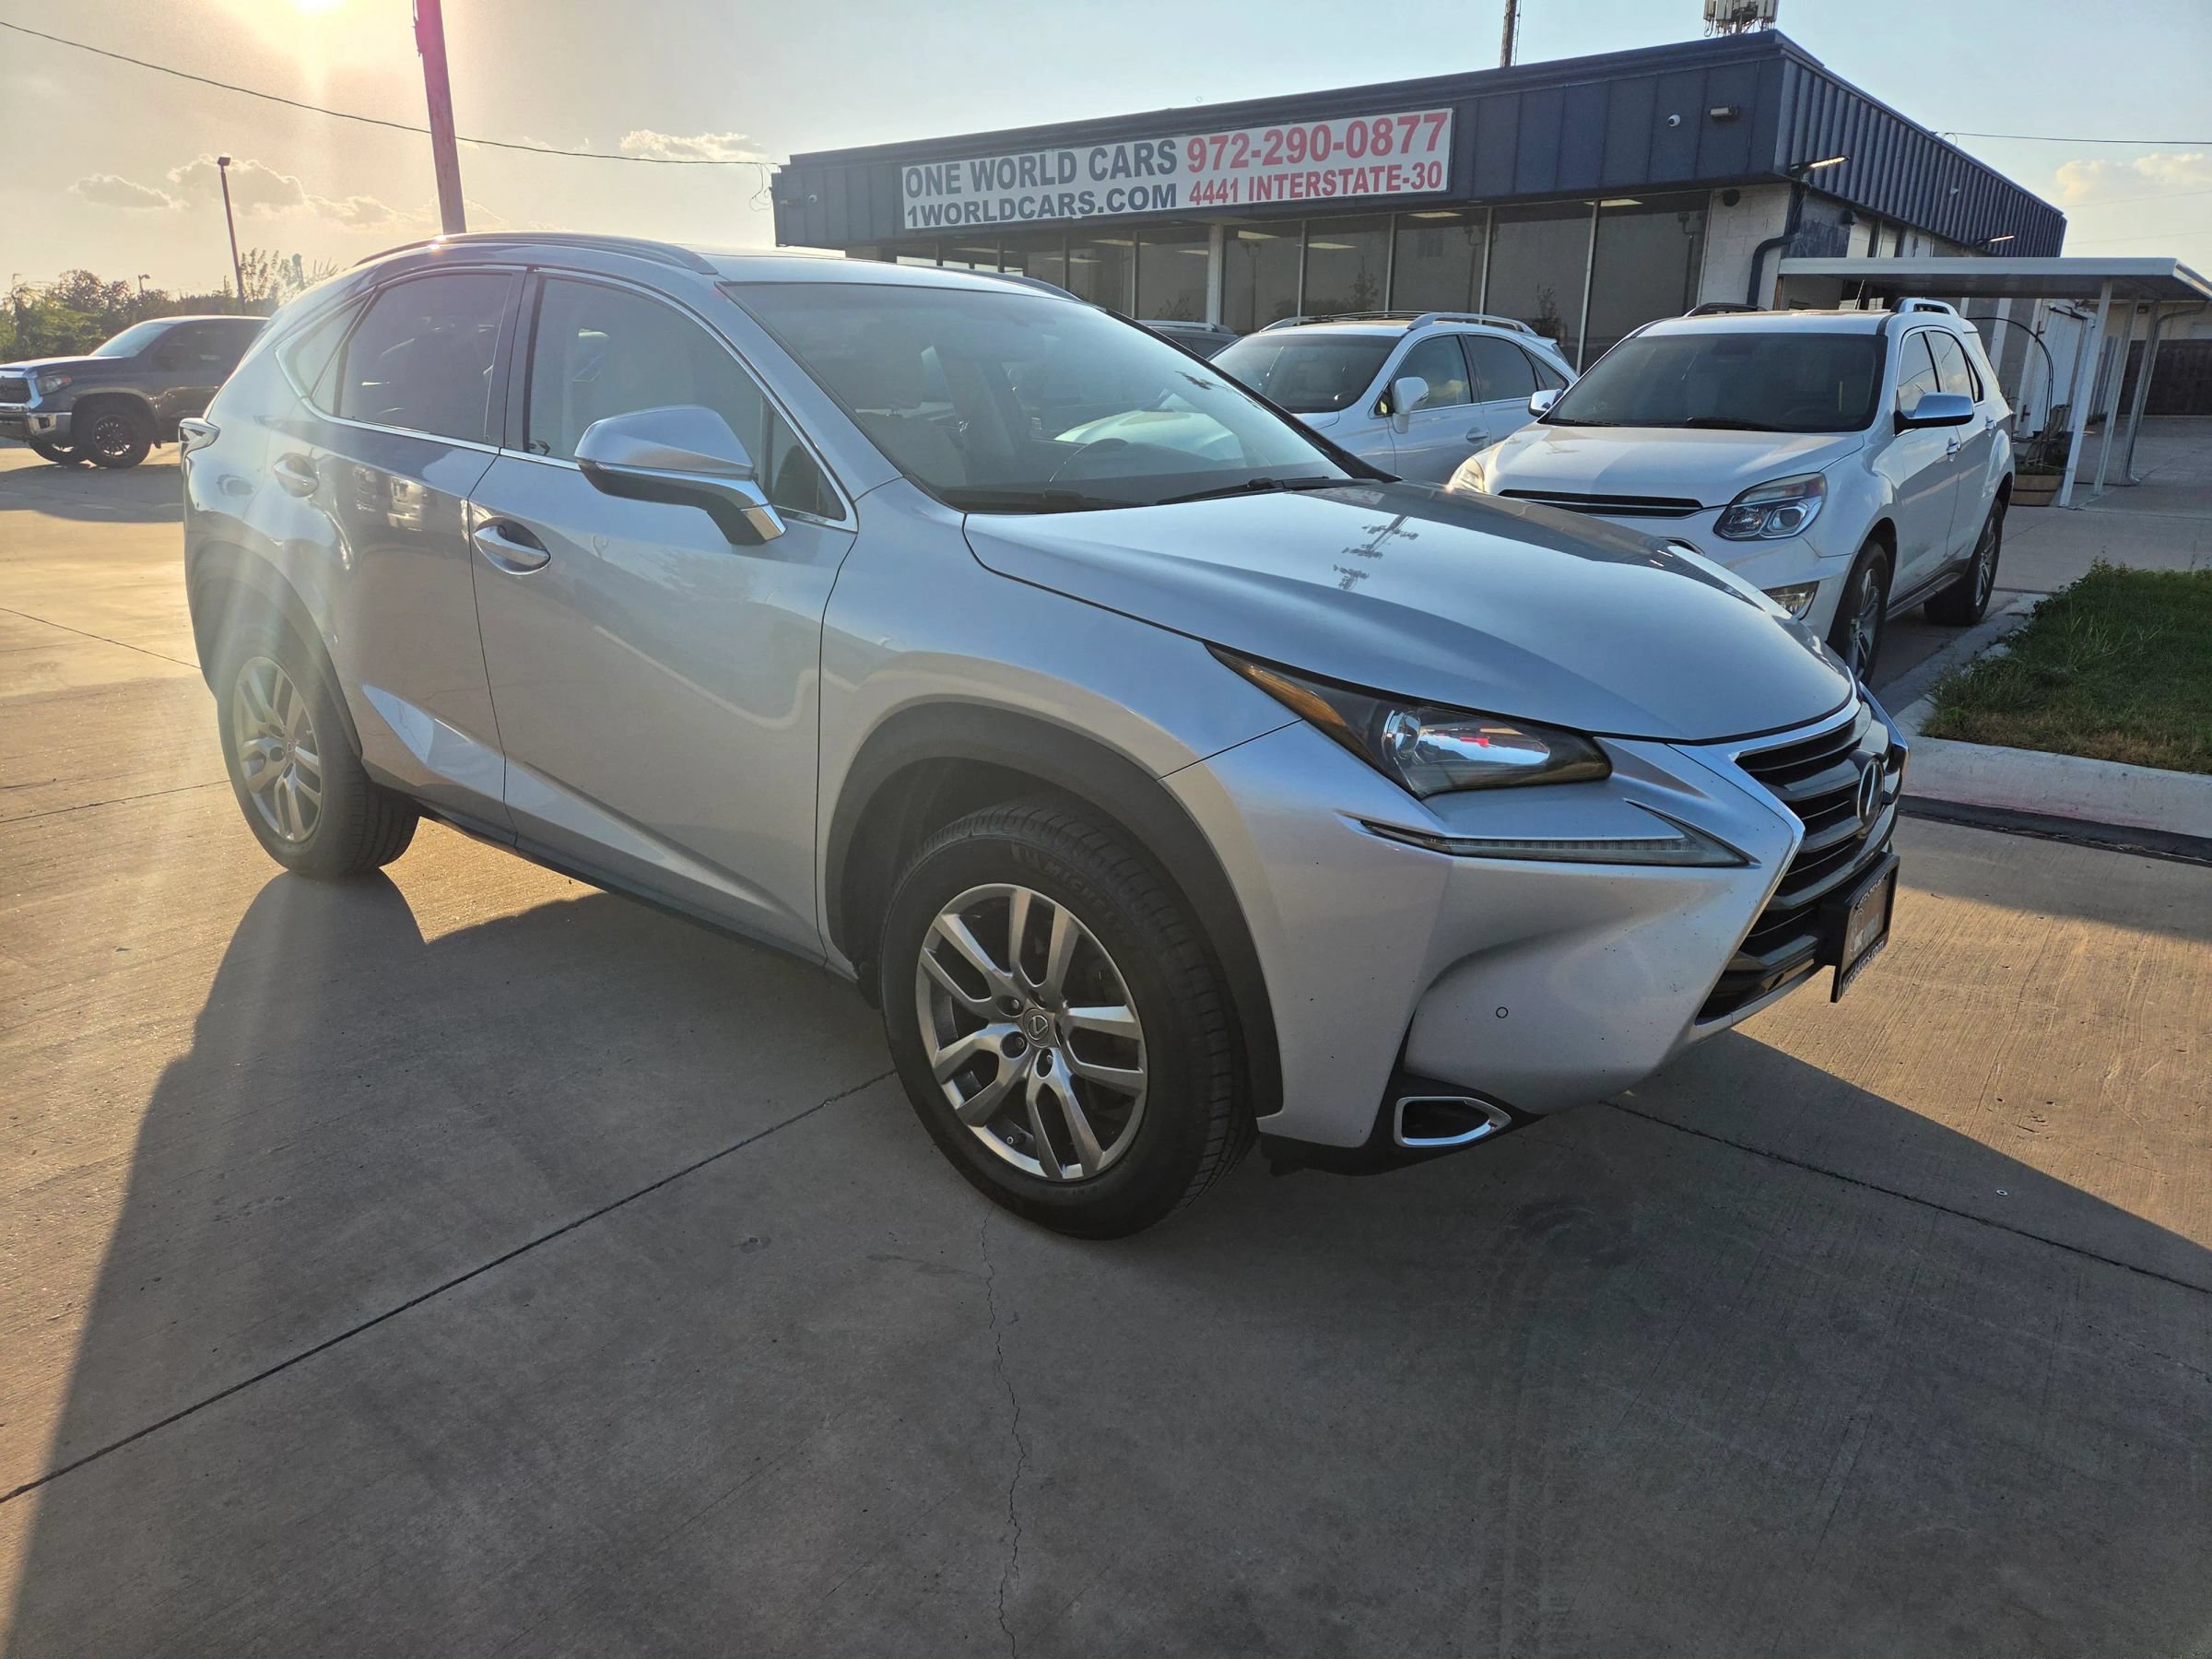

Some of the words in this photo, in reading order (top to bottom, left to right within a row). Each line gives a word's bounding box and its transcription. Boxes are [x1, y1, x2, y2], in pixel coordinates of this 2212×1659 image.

[905, 163, 961, 198] ONE
[970, 151, 1077, 192] WORLD
[1088, 139, 1178, 182] CARS
[1187, 112, 1448, 173] 972-290-0877
[907, 183, 1177, 228] 1WORLDCARS.COM
[1189, 177, 1239, 206] 4441
[1249, 160, 1442, 201] INTERSTATE-30
